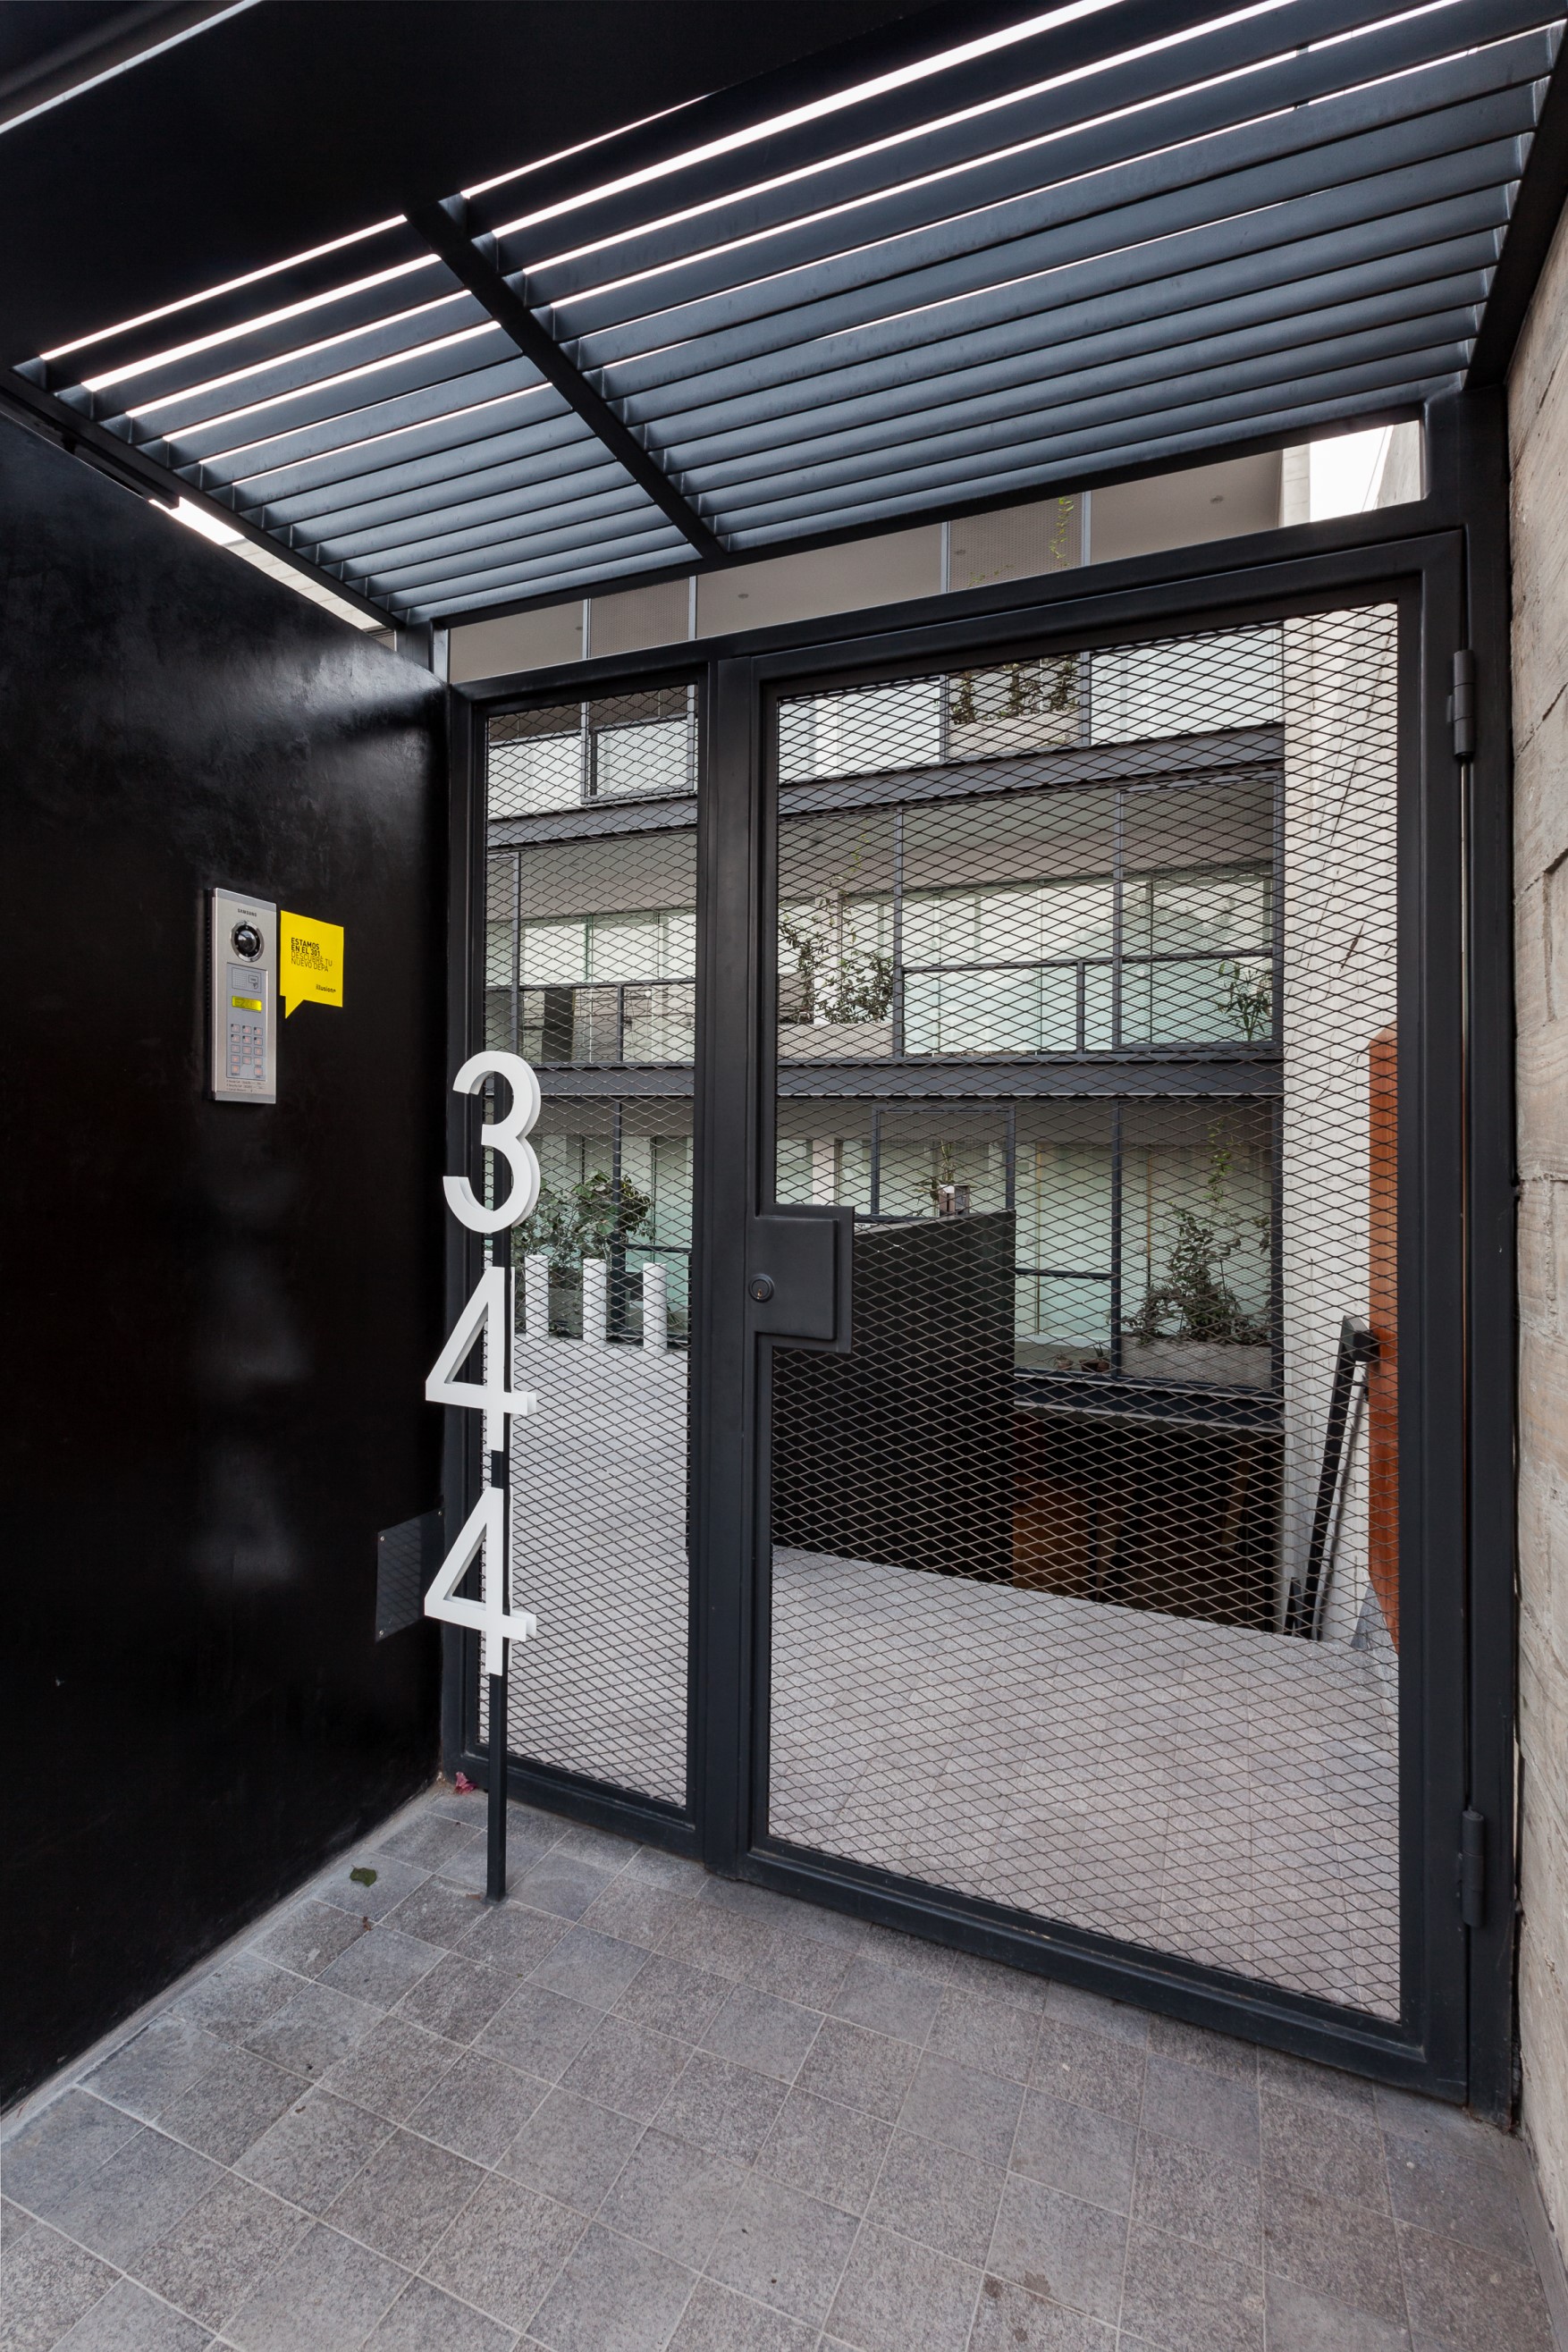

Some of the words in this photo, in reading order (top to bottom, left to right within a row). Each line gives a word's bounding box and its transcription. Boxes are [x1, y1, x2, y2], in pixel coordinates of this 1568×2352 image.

[237, 907, 257, 917] SAMSUNG
[291, 937, 320, 950] ESTAMOS
[291, 944, 300, 952] EN
[301, 946, 309, 955] EL
[291, 950, 324, 964] DESCUBRE
[325, 958, 333, 966] TU
[291, 957, 313, 968] NUEVO
[313, 963, 329, 973] DEPA
